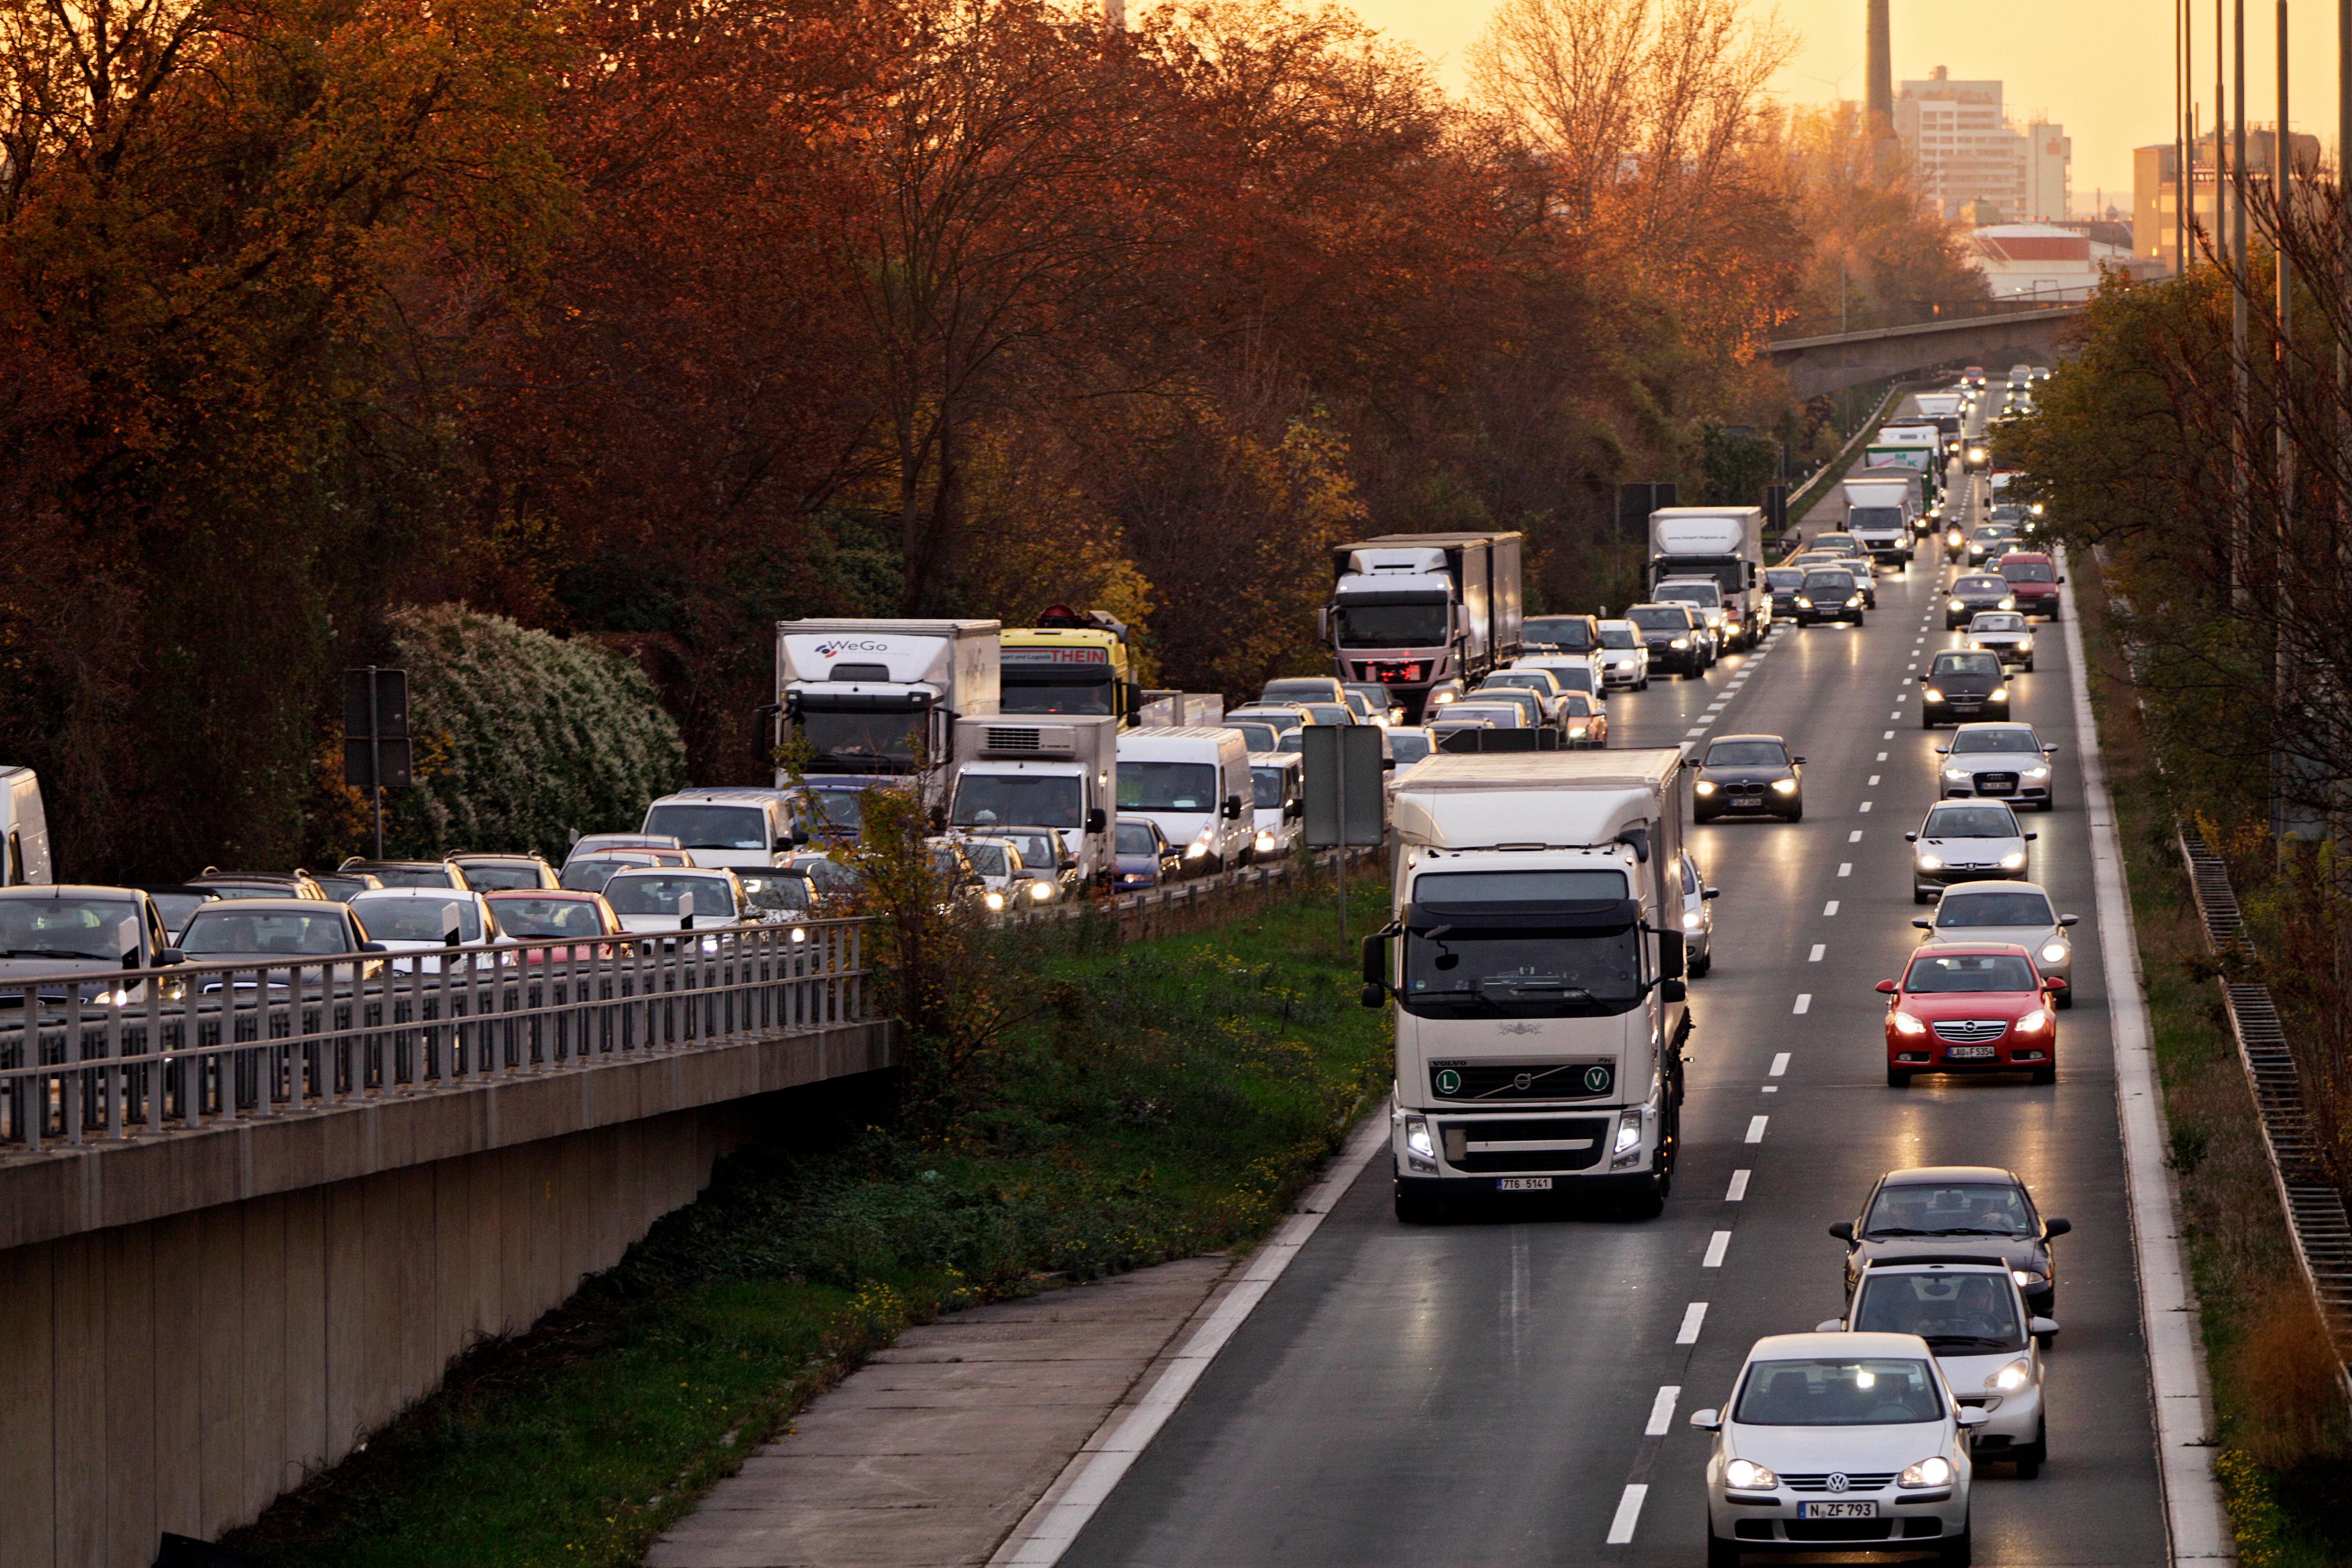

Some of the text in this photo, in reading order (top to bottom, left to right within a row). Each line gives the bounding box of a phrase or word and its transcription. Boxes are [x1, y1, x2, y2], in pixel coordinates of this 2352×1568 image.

[828, 640, 888, 651] WeGo
[1052, 650, 1105, 663] THEIN
[1443, 1074, 1454, 1090] L
[1591, 1072, 1603, 1086] V
[1503, 1179, 1548, 1189] 7T6 5141
[1810, 1503, 1871, 1517] N ZF 793
